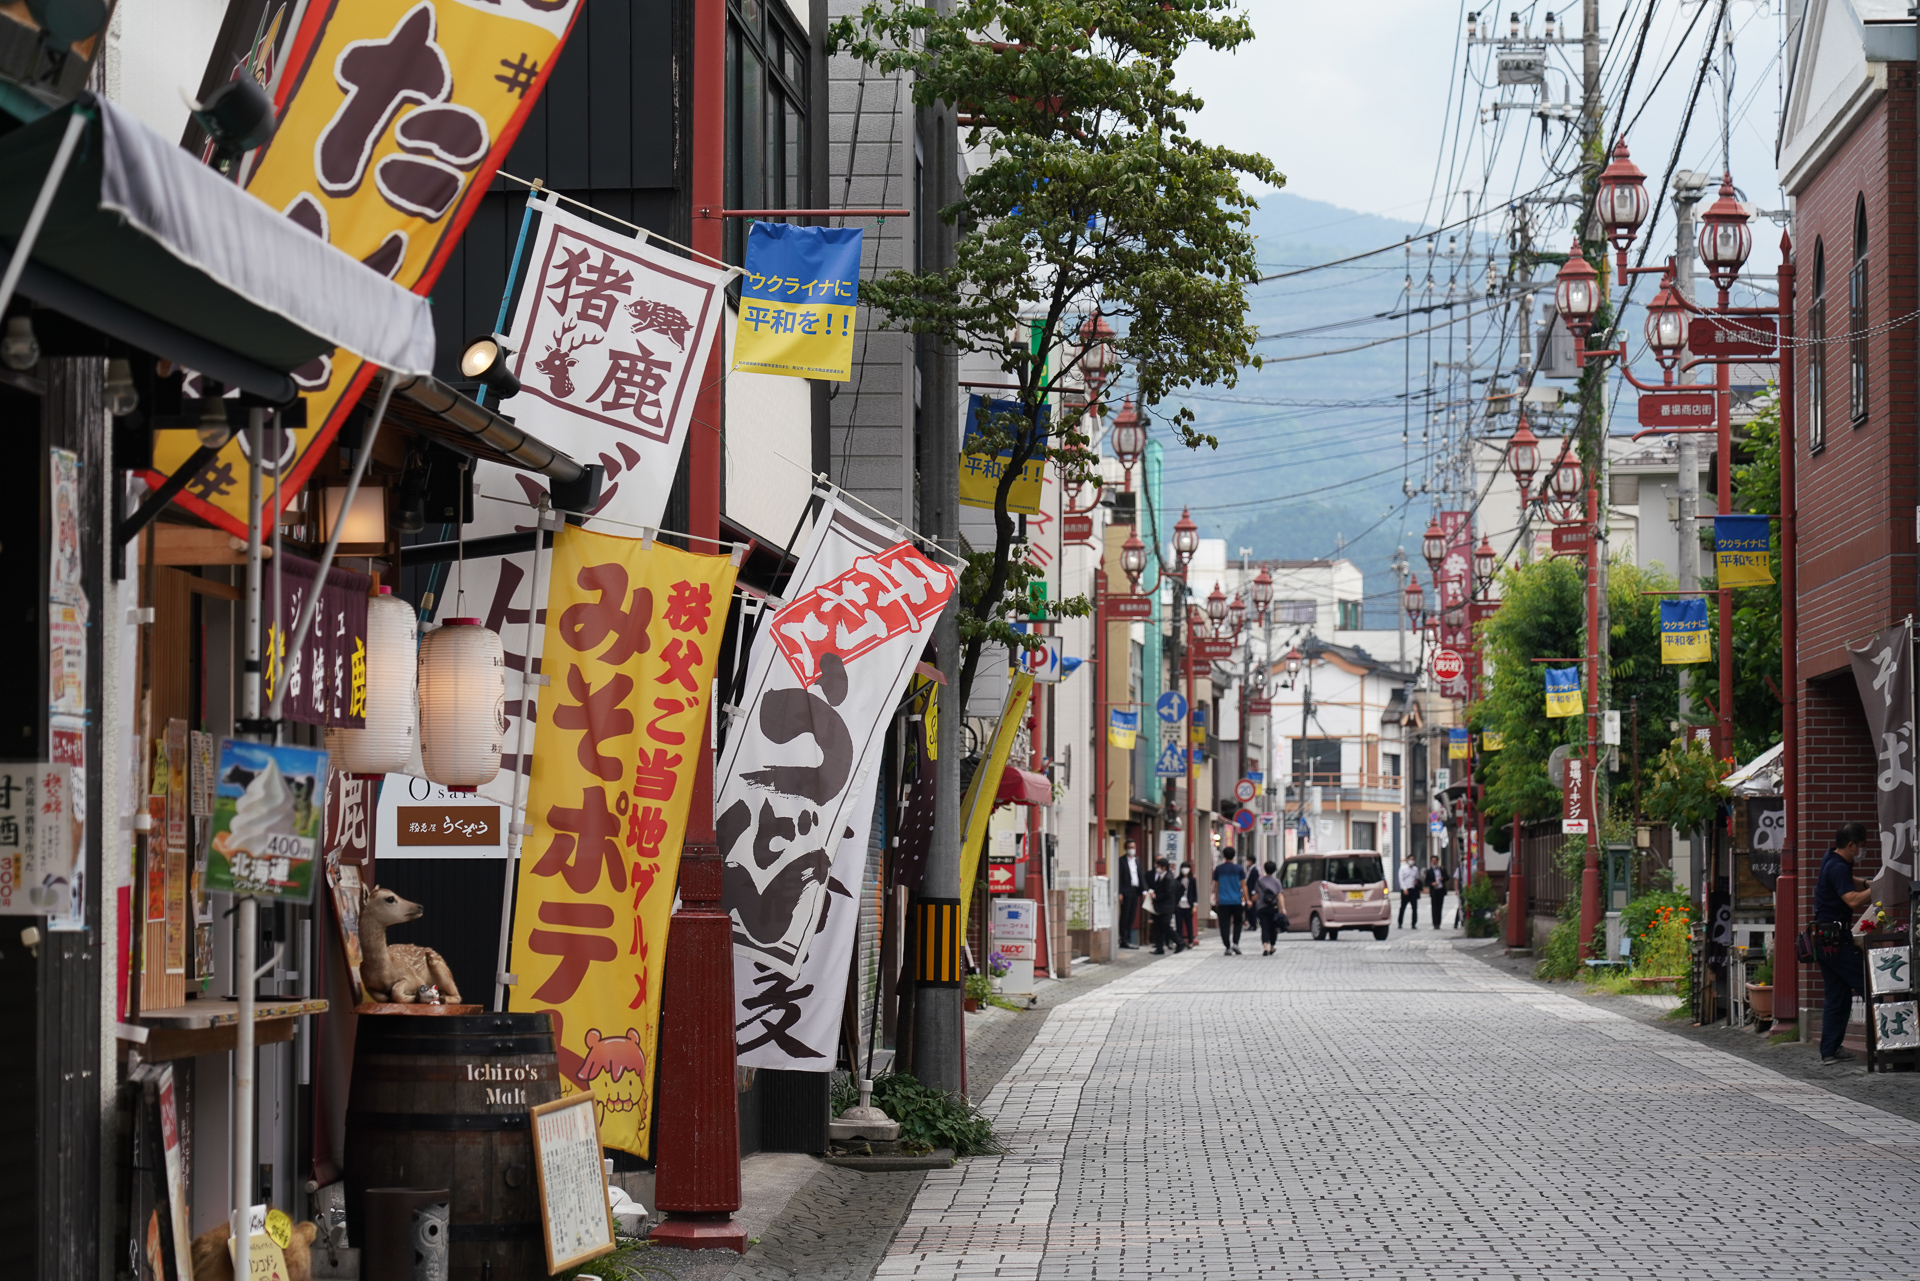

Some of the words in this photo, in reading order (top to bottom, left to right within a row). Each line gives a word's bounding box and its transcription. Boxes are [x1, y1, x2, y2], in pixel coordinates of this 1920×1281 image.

[748, 272, 852, 297] ウクライナに
[1714, 329, 1773, 343] 番場商店街
[1660, 404, 1712, 416] 番場商店街
[1718, 539, 1767, 549] ウクライナに
[290, 586, 346, 637] ジビエ
[1663, 619, 1707, 630] ウクライナに
[1435, 658, 1462, 672] 消火栓
[627, 579, 712, 1010] 秩父ご当地グルメ
[1239, 785, 1251, 797] 20
[1569, 759, 1583, 819] 番場パーキング
[443, 815, 488, 837] らくぞう
[230, 852, 290, 883] 北海道
[466, 1062, 539, 1083] Ichiro's
[485, 1086, 527, 1105] Malt
